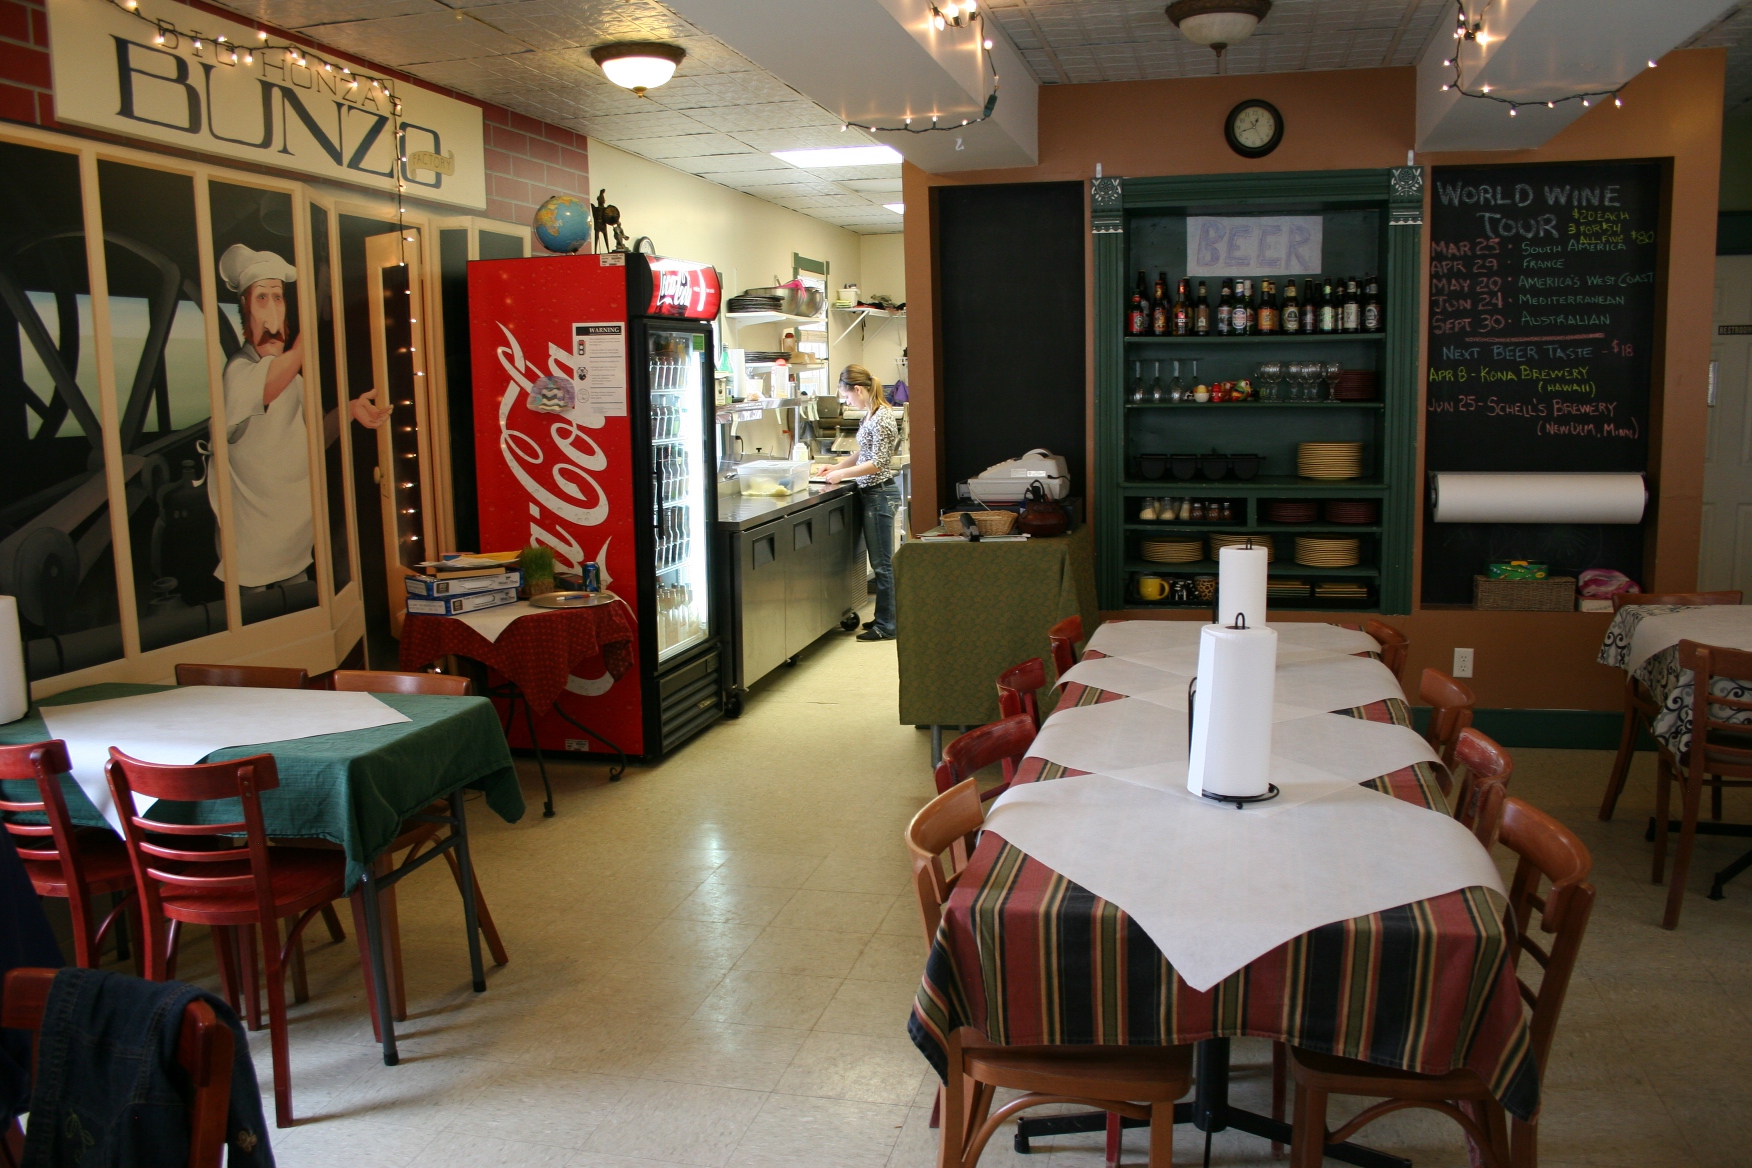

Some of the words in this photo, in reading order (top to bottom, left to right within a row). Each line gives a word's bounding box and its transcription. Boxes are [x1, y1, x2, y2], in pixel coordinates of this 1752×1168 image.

[109, 34, 442, 189] BUNZO
[412, 153, 451, 169] FACTORY
[1437, 181, 1533, 207] WORLD
[1544, 185, 1621, 207] WINE
[1572, 208, 1595, 222] $20
[1597, 211, 1630, 221] EACH
[1476, 212, 1559, 239] TOUR
[1568, 223, 1577, 234] 3
[1580, 225, 1601, 234] FOR
[1197, 220, 1312, 272] BEER
[1631, 230, 1655, 244] $80
[1431, 241, 1472, 257] MAR
[1475, 238, 1500, 254] 25
[1522, 242, 1562, 255] SOUTH
[1567, 239, 1626, 251] AMERICA
[1431, 260, 1467, 275] APR
[1472, 258, 1498, 273] 29
[1523, 257, 1565, 269] FRANCE
[1432, 278, 1470, 294] MAY
[1476, 277, 1501, 292] 20
[1518, 274, 1580, 289] AMERICA'S
[1586, 275, 1616, 286] WEST
[1617, 272, 1654, 287] COAST
[1431, 296, 1472, 312] JUN
[1478, 292, 1503, 310] 24
[1519, 294, 1625, 306] MEDITERRANEAN
[1432, 315, 1472, 334] SEPT
[1478, 315, 1505, 332] 30
[1521, 310, 1610, 326] AUSTRALIAN
[1443, 345, 1480, 360] NEXT
[1491, 345, 1539, 361] BEER
[1543, 345, 1593, 359] TASTE
[1612, 339, 1634, 357] $18
[1429, 367, 1454, 382] APR
[1457, 366, 1468, 382] 8
[1480, 365, 1517, 383] KONA
[1519, 365, 1589, 380] BREWERY
[1538, 381, 1596, 398] (HAWAII)
[1428, 398, 1454, 412] JUN
[1486, 396, 1547, 417] SCHELL'S
[1553, 399, 1618, 417] BREWERY
